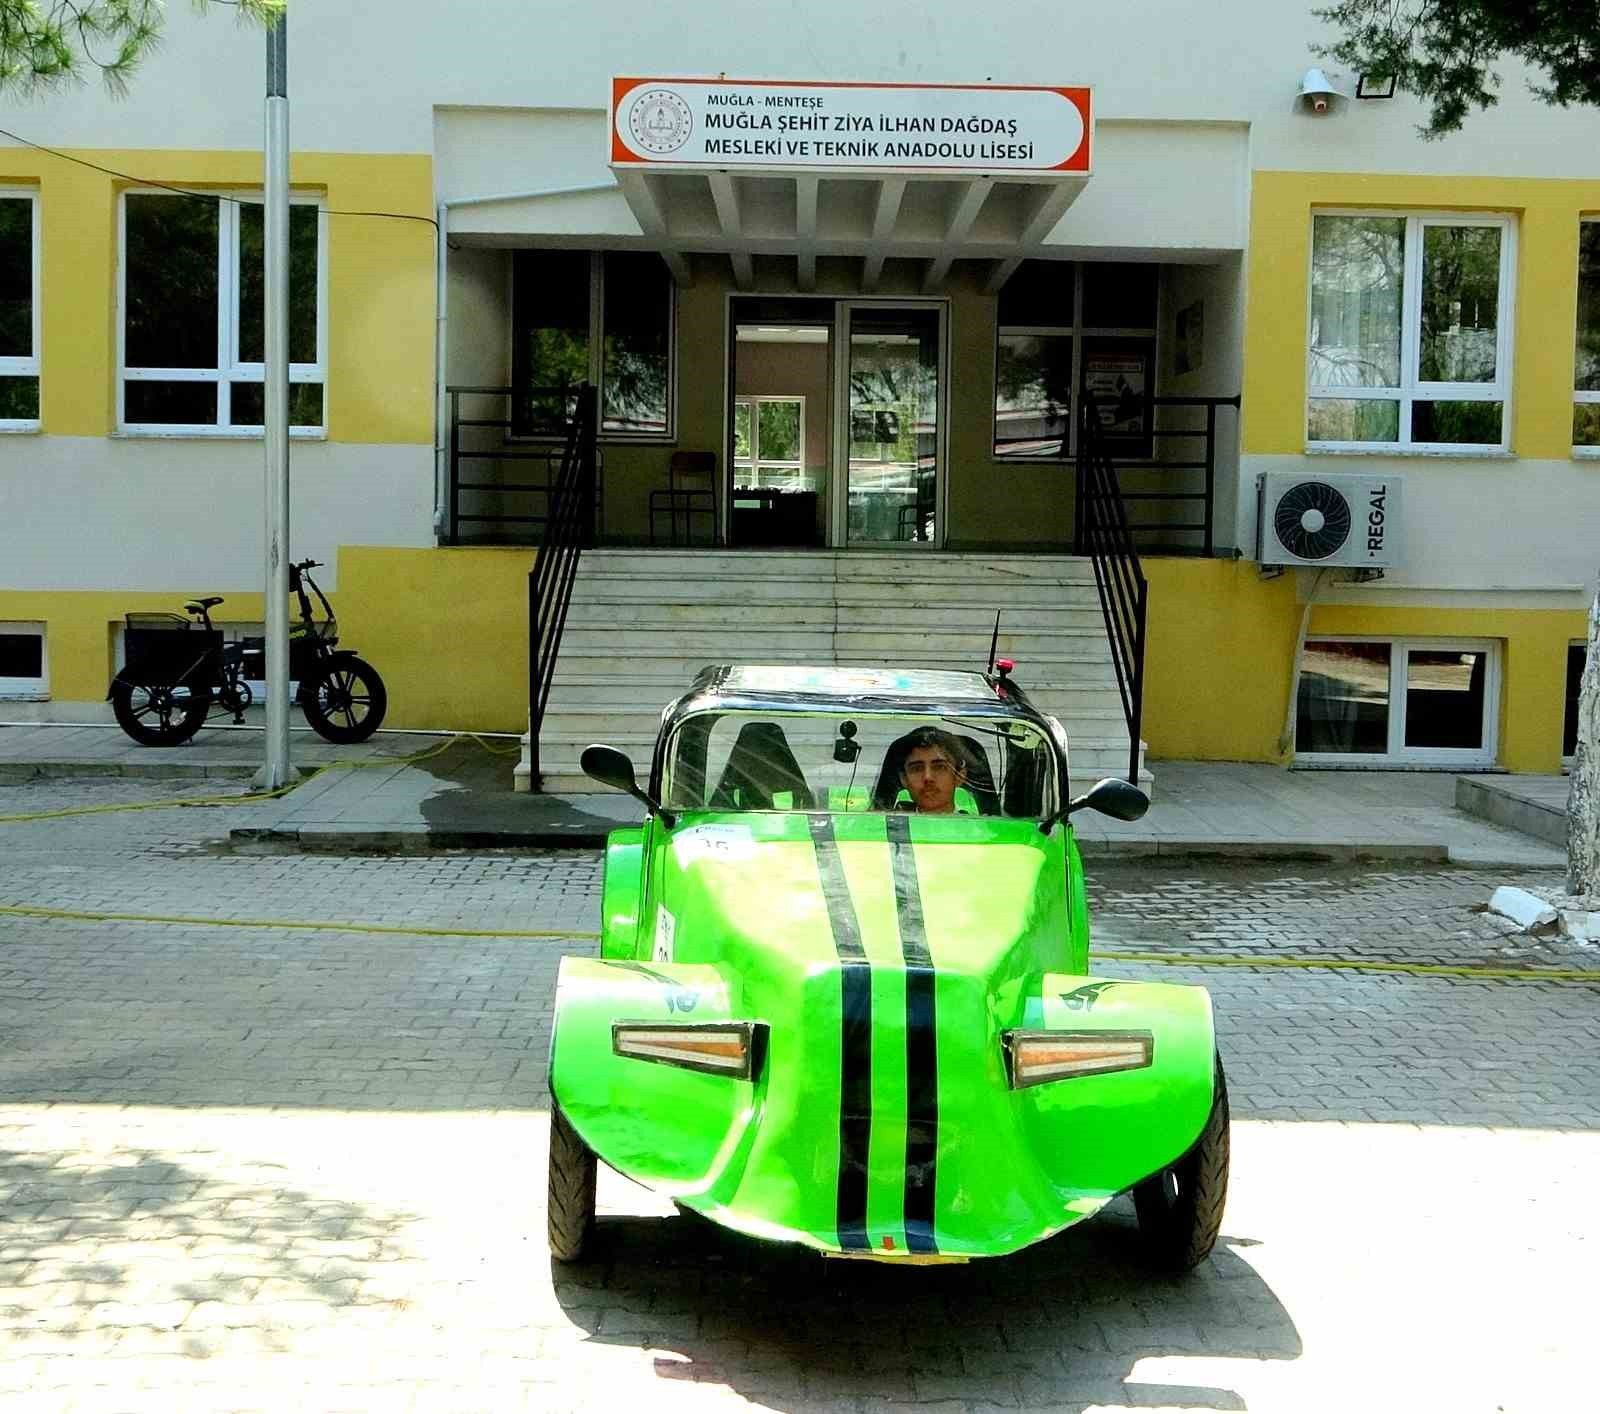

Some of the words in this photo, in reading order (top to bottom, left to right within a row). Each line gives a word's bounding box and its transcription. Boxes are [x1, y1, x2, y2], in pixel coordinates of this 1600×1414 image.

[707, 93, 755, 106] MUĞLA
[765, 96, 825, 110] MENTEŞE
[705, 111, 772, 129] MUĞLA
[778, 112, 830, 133] ŞEHİT
[834, 113, 874, 132] ZİYA
[879, 114, 936, 132] İLHAN
[940, 115, 1018, 137] DAĞDAŞ
[704, 137, 781, 155] MESLEKİ
[786, 141, 809, 155] VE
[813, 138, 879, 157] TEKNİK
[884, 142, 976, 159] ANADOLU
[980, 141, 1034, 160] LİSESİ
[1367, 484, 1386, 551] REGAL
